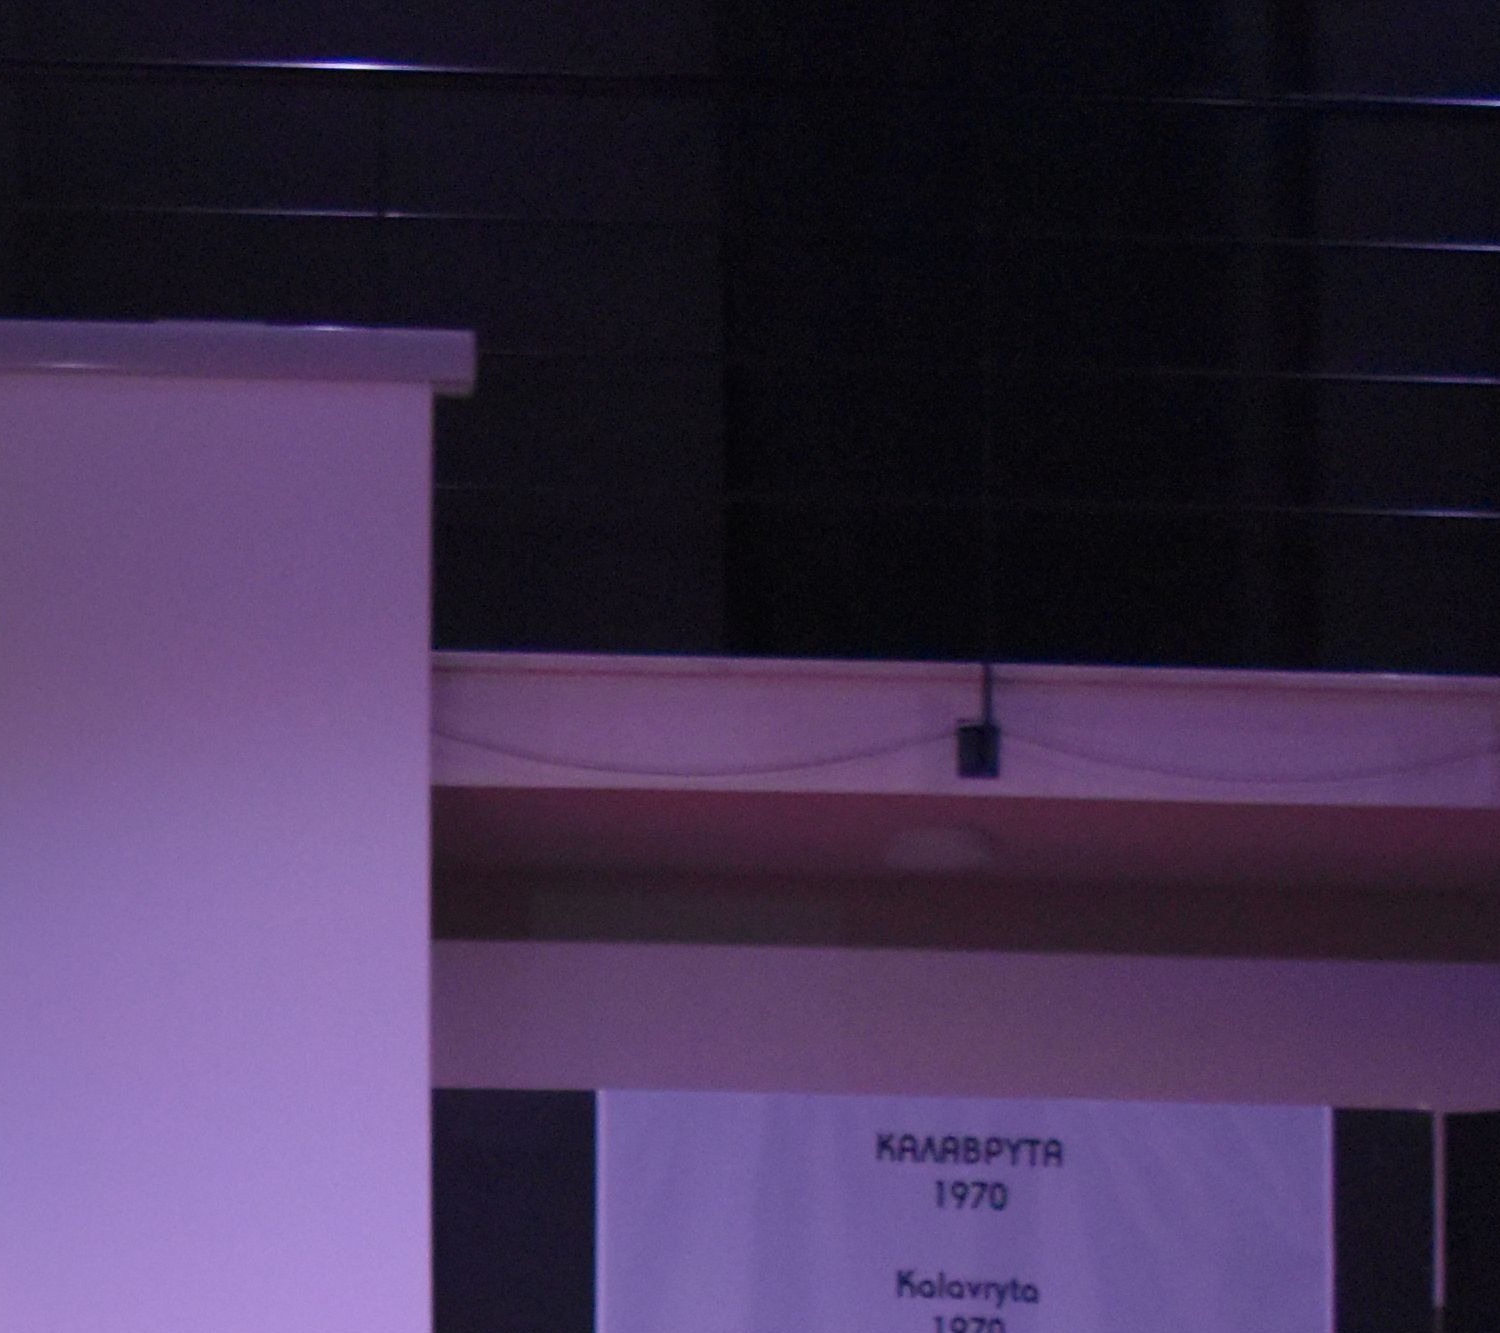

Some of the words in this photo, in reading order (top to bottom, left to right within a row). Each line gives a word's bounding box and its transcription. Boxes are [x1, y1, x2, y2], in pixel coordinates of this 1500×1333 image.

[876, 1133, 1063, 1166] ΚΑΛΑΒΡΥΤΑ
[935, 1180, 1009, 1212] 1970
[896, 1270, 1039, 1309] Kalavryta
